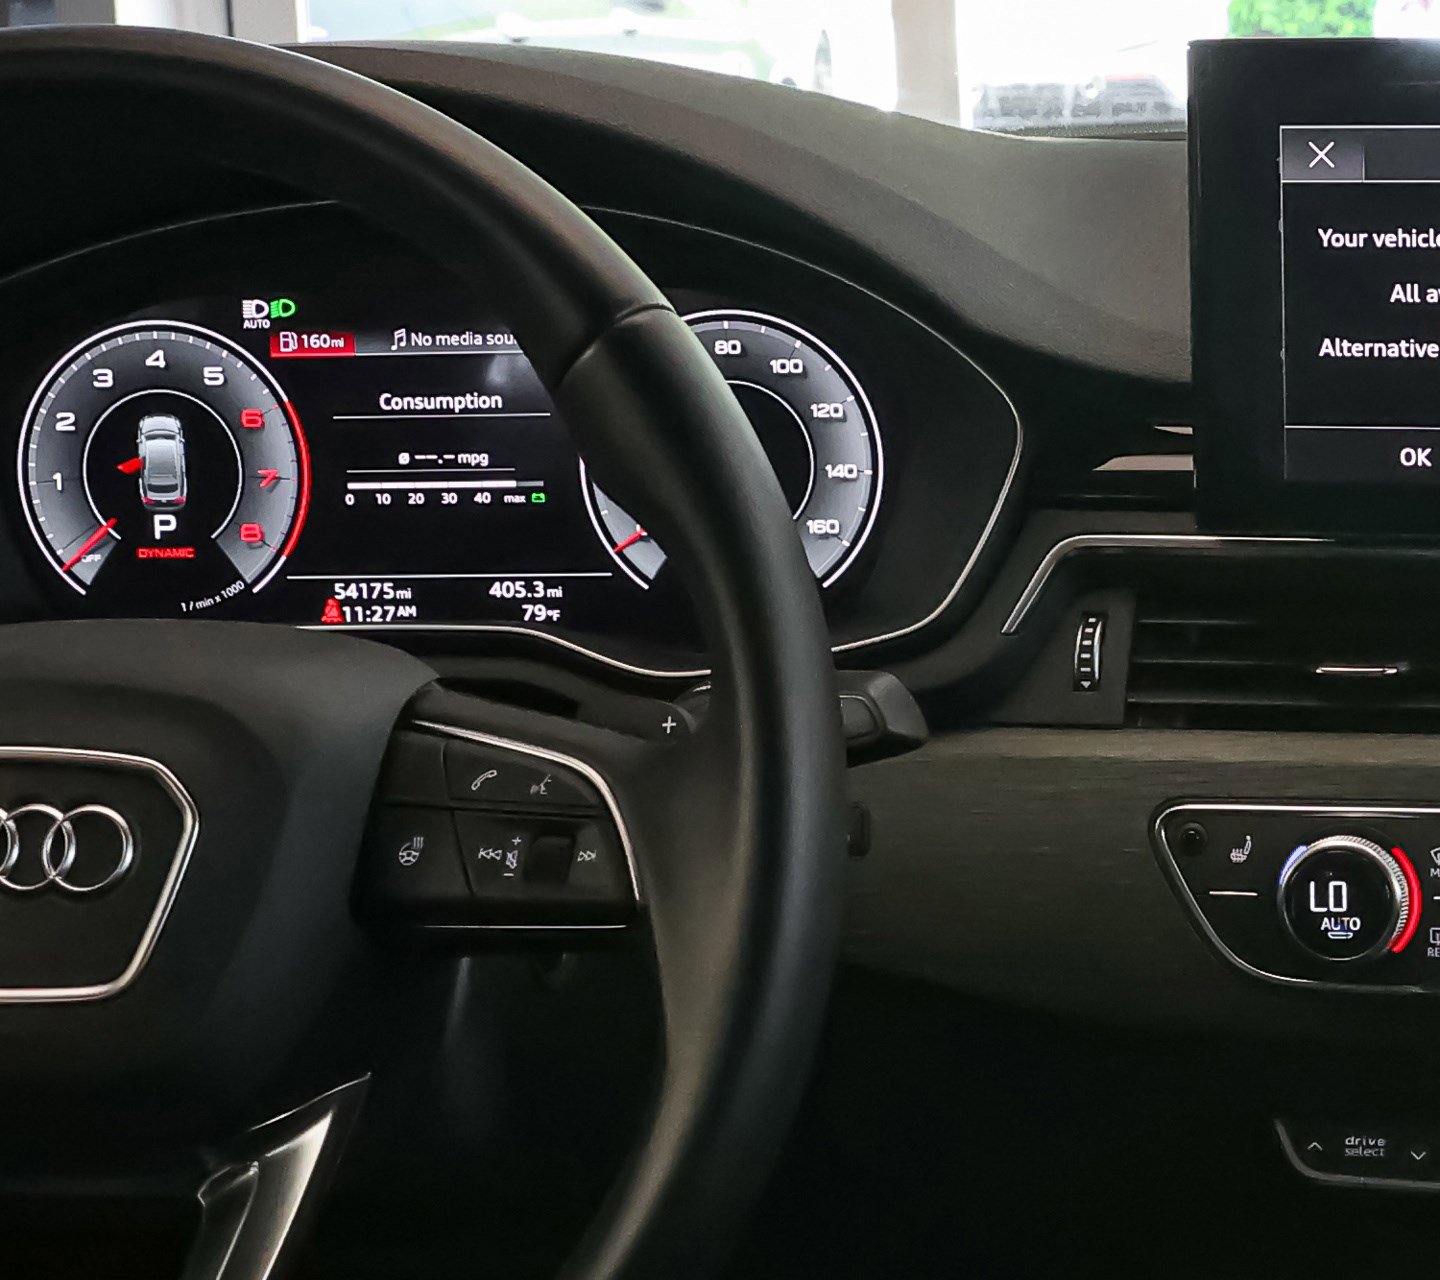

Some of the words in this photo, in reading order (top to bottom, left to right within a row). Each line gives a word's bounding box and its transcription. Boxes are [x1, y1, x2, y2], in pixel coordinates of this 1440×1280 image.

[1318, 229, 1368, 247] Your
[1390, 284, 1421, 303] All
[243, 319, 270, 328] AUTO
[411, 333, 432, 346] No
[436, 332, 483, 346] media
[486, 333, 517, 346] sou
[714, 340, 741, 354] 80
[1319, 338, 1439, 357] Alternative
[145, 350, 166, 368] 4
[770, 359, 803, 373] 100
[93, 368, 114, 387] 3
[203, 366, 225, 386] 5
[380, 392, 502, 413] Consumption
[810, 403, 844, 418] 120
[55, 412, 76, 431] 2
[241, 408, 264, 429] 6
[458, 453, 489, 466] mpg
[1400, 448, 1432, 466] OK
[258, 469, 279, 488] 7
[825, 464, 858, 478] 140
[52, 472, 63, 491] 1
[345, 493, 355, 505] 0
[376, 493, 392, 505] 10
[408, 493, 425, 505] 20
[441, 493, 458, 505] 30
[474, 492, 492, 504] 40
[504, 493, 526, 504] max
[153, 514, 177, 540] P
[240, 523, 264, 542] 8
[806, 520, 840, 534] 160
[138, 548, 195, 558] DYNAMIC
[222, 580, 245, 599] 1000
[1321, 916, 1360, 932] AUTO
[1344, 1136, 1386, 1146] drive
[1344, 1146, 1386, 1157] select
